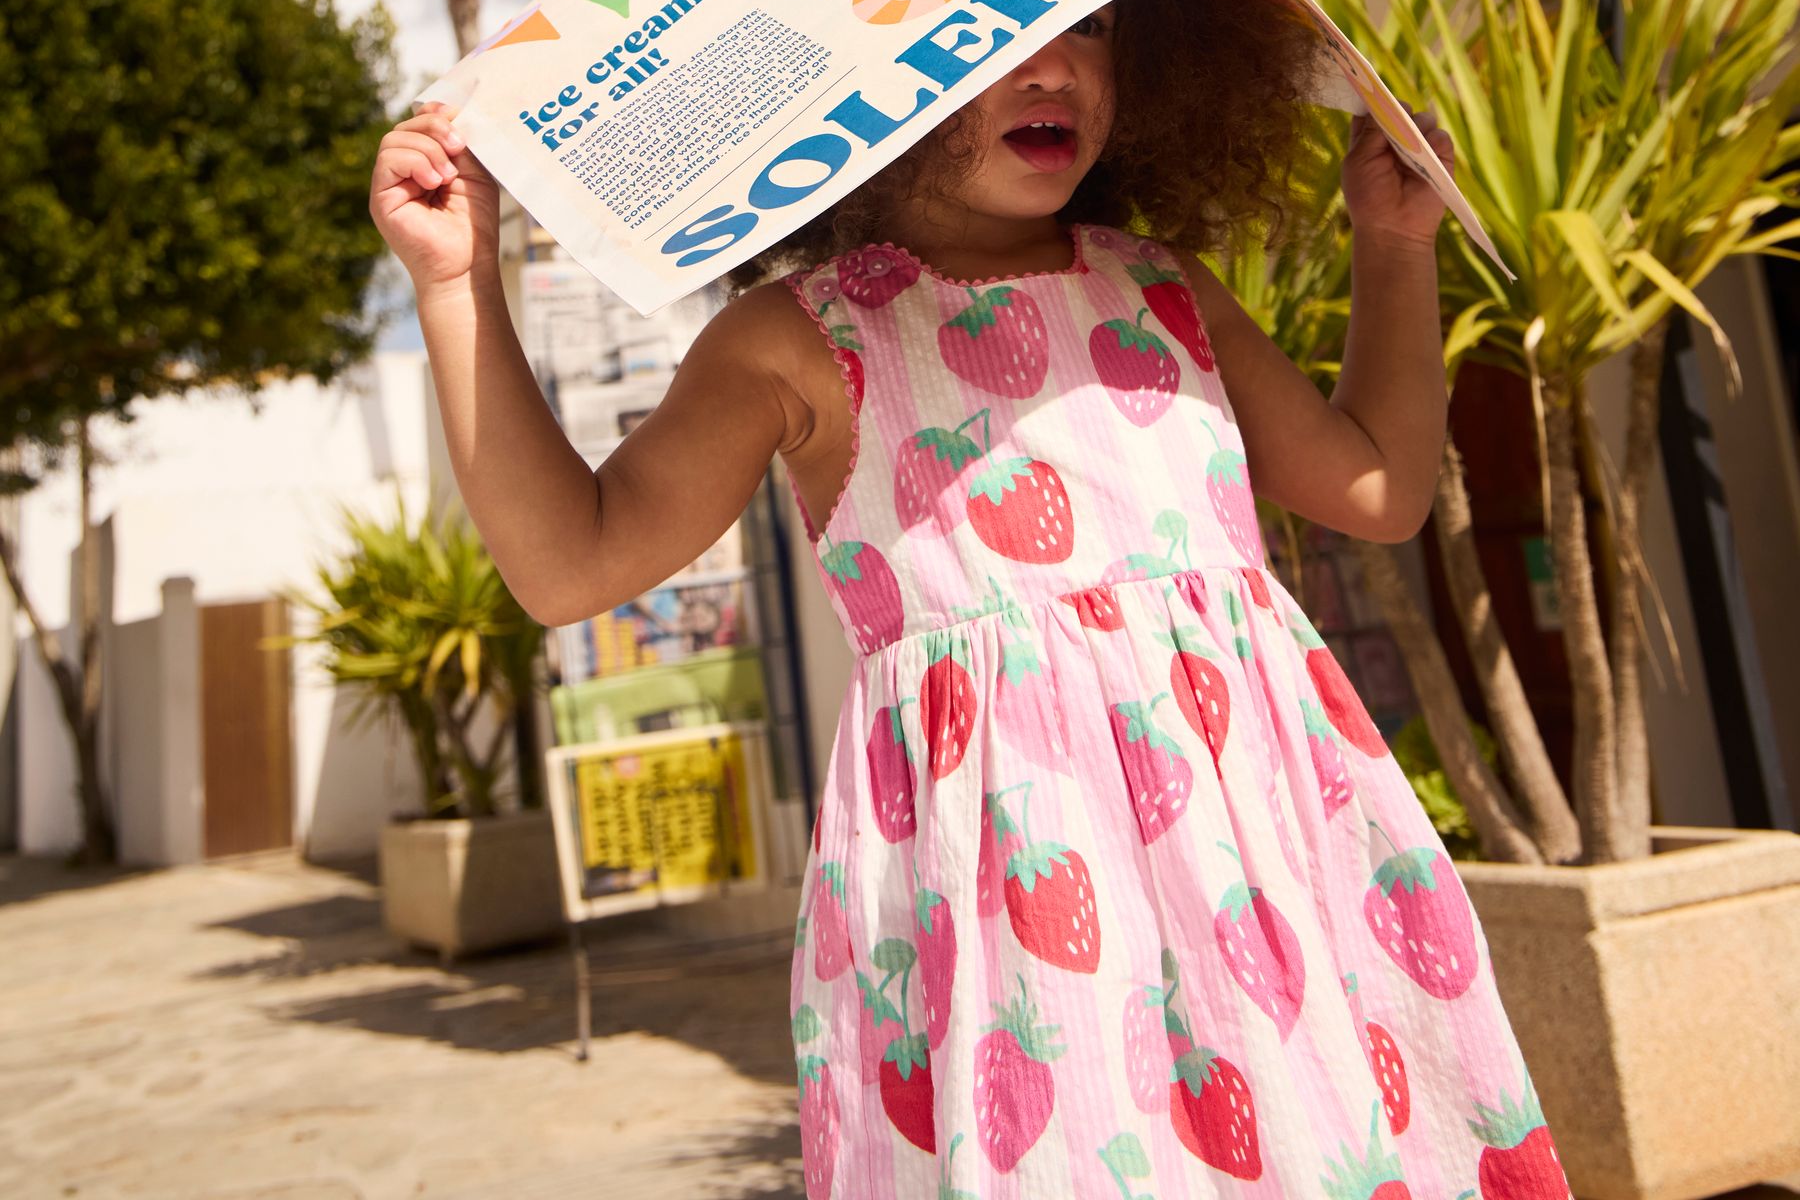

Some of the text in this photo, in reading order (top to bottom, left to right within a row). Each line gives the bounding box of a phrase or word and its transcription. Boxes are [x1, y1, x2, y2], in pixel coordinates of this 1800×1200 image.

[519, 85, 583, 135] ice
[541, 47, 670, 152] for all!
[557, 7, 761, 163] Big scoop news from the JoJo Gazette:
[563, 11, 767, 167] ice cream season is in full swing! Kids
[570, 16, 773, 173] were spotted enjoying colourful cones
[575, 18, 779, 179] while debating the most important
[581, 141, 630, 185] question
[630, 129, 643, 141] of
[645, 94, 691, 129] summer
[698, 58, 737, 88] what's
[737, 43, 758, 58] the
[759, 22, 784, 42] best
[586, 26, 791, 190] flavour ever? Strawberry swirl, cookie
[592, 30, 798, 196] crunch, and sprinkle-topped classics
[599, 33, 807, 201] were all strong contenders. One thing
[605, 37, 811, 208] everyone agreed on: ice cream tastes
[610, 41, 819, 211] even better when shared with friends.
[615, 45, 825, 216] So whether you love sprinkles, waffle
[622, 50, 832, 223] cones, or extra scoops, there's only one
[628, 63, 827, 229] rule this summer... Ice creams for all!
